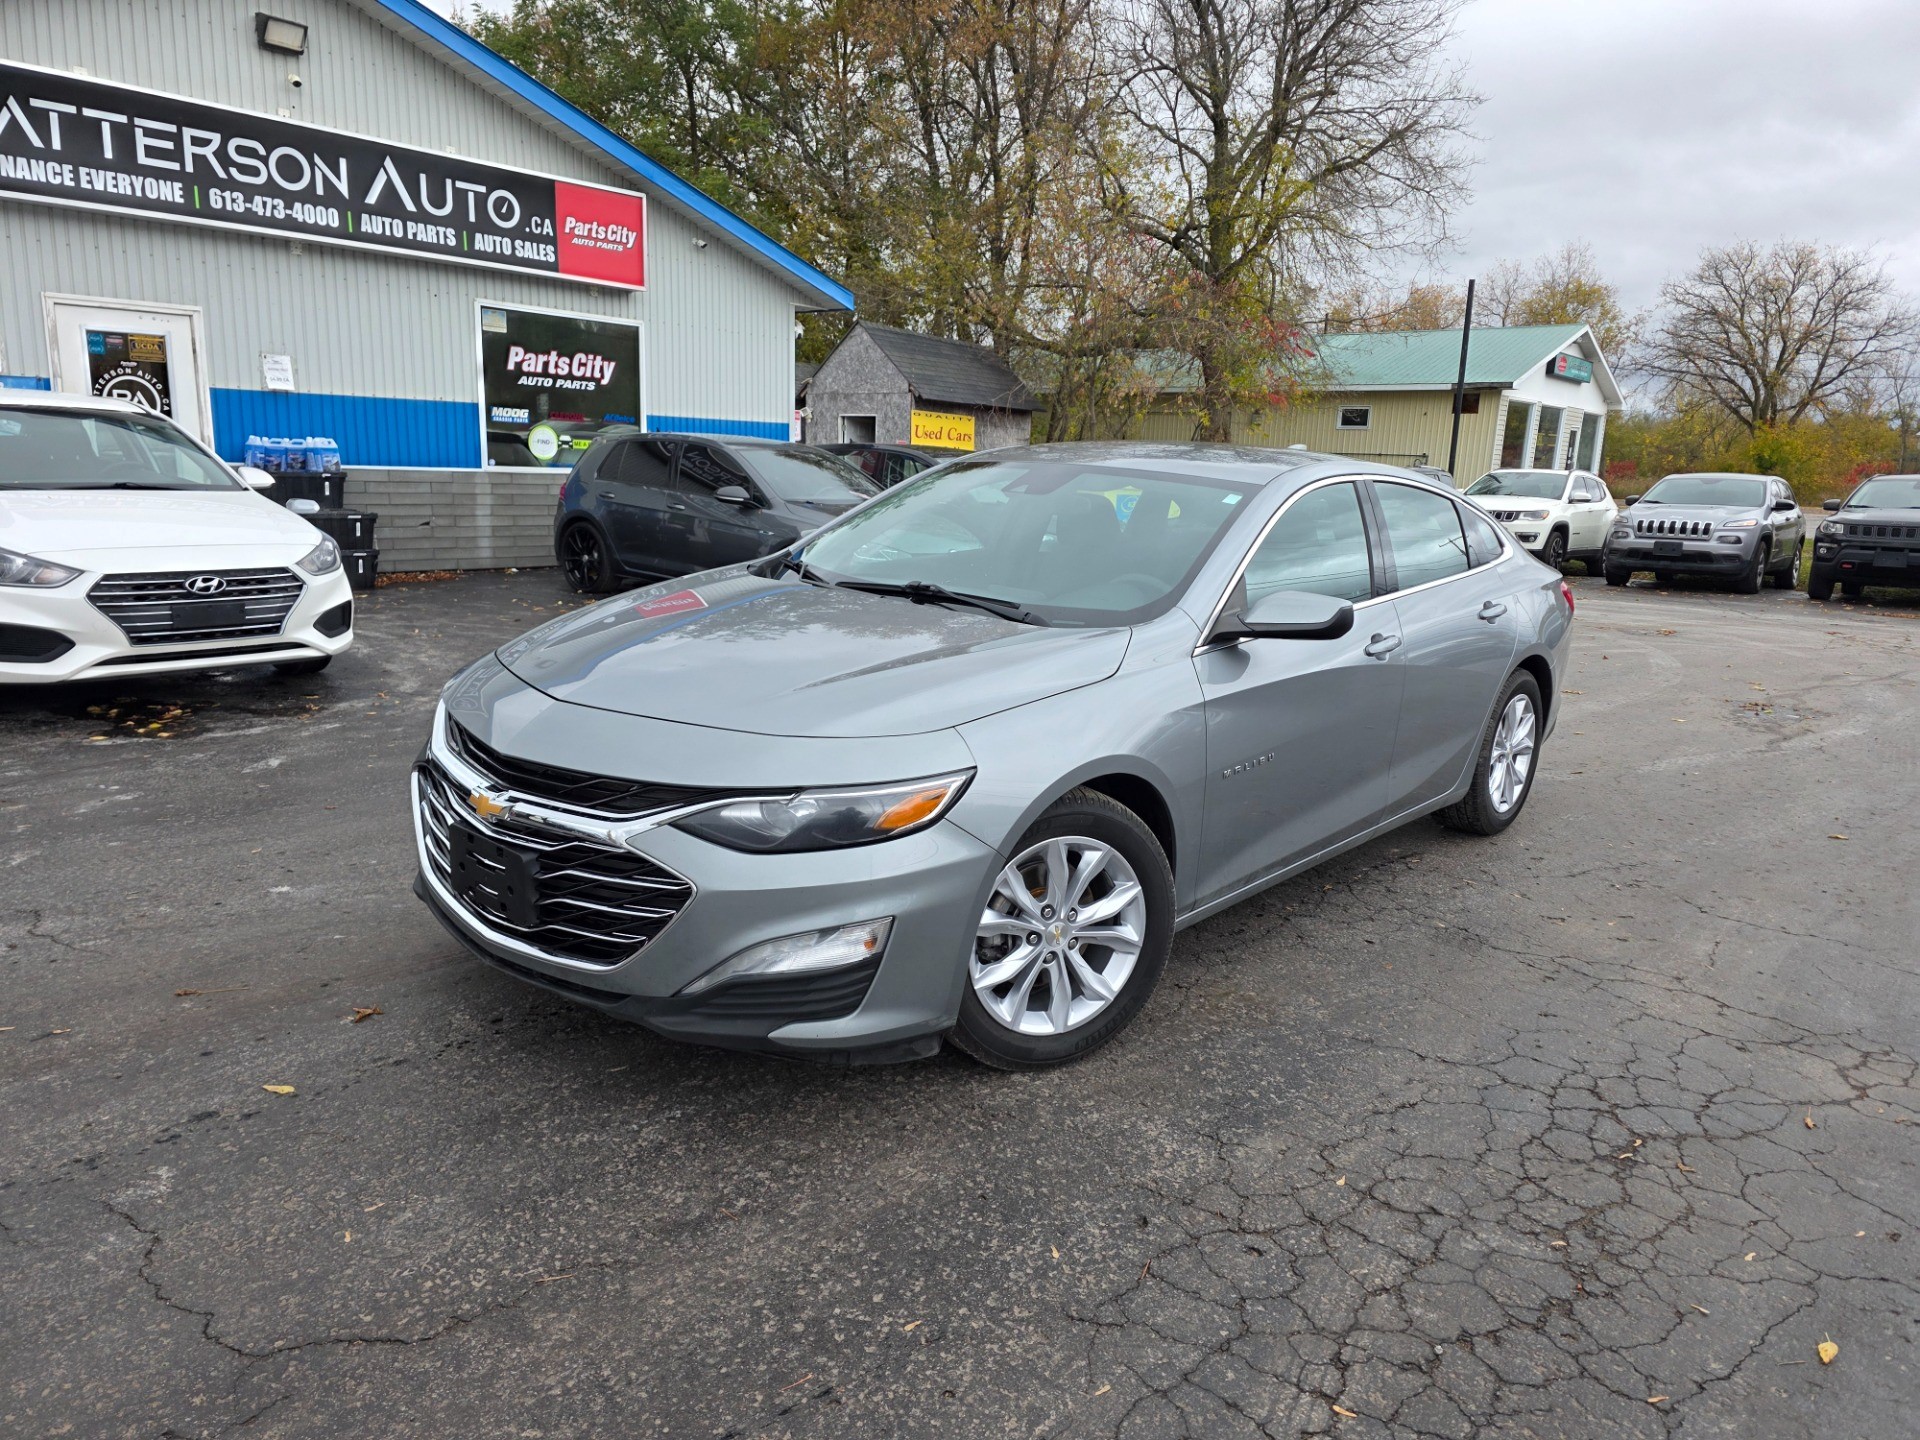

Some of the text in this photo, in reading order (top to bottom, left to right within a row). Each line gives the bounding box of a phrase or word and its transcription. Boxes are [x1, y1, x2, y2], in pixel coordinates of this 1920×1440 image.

[79, 166, 185, 204] EVERYONE
[364, 155, 521, 229] AUTO
[208, 187, 340, 228] 613-473-4000
[361, 212, 457, 247] AUTO PARTS
[474, 232, 555, 263] AUTO SALES
[571, 237, 624, 252] AUTO PARTS
[134, 342, 160, 351] UCDA
[137, 370, 163, 390] AUTO
[517, 375, 596, 391] AUTO PARTS
[491, 406, 530, 418] MOOG
[914, 424, 972, 443] Used Cars
[1222, 752, 1275, 779] MALIBU
